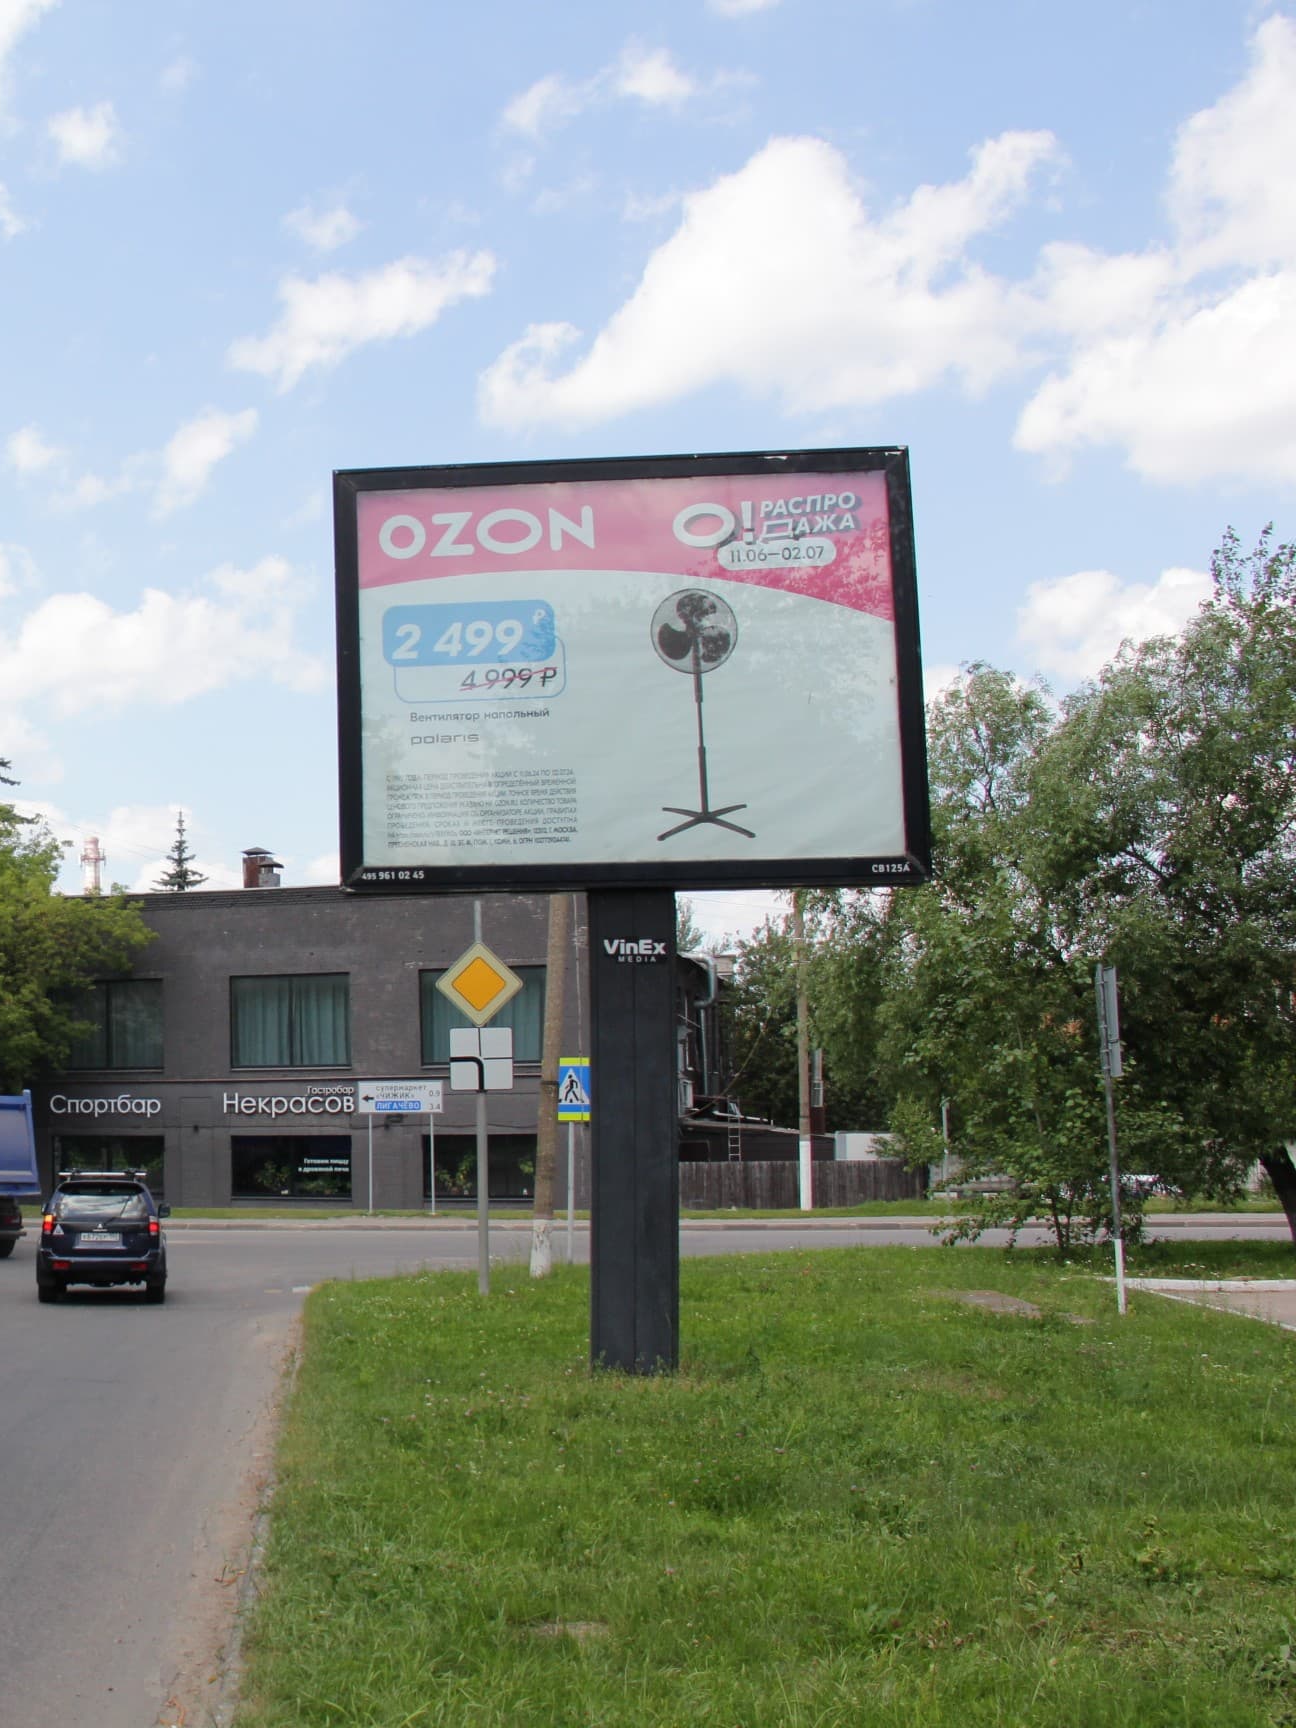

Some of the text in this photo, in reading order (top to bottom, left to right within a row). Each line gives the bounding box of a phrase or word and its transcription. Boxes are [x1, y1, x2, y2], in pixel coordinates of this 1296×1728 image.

[759, 491, 857, 518] РАСПРО
[379, 505, 595, 560] OZON
[759, 513, 857, 545] ДАЖА
[432, 618, 524, 658] 499
[409, 708, 551, 723] Вентилятор напольный
[410, 733, 480, 747] polaris
[378, 871, 396, 880] 961
[398, 871, 411, 880] 02
[412, 870, 425, 879] 45
[603, 939, 666, 955] VinEx
[617, 955, 657, 963] MEDIA
[49, 1094, 161, 1118] Спортбар
[223, 1092, 355, 1119] Некрасов
